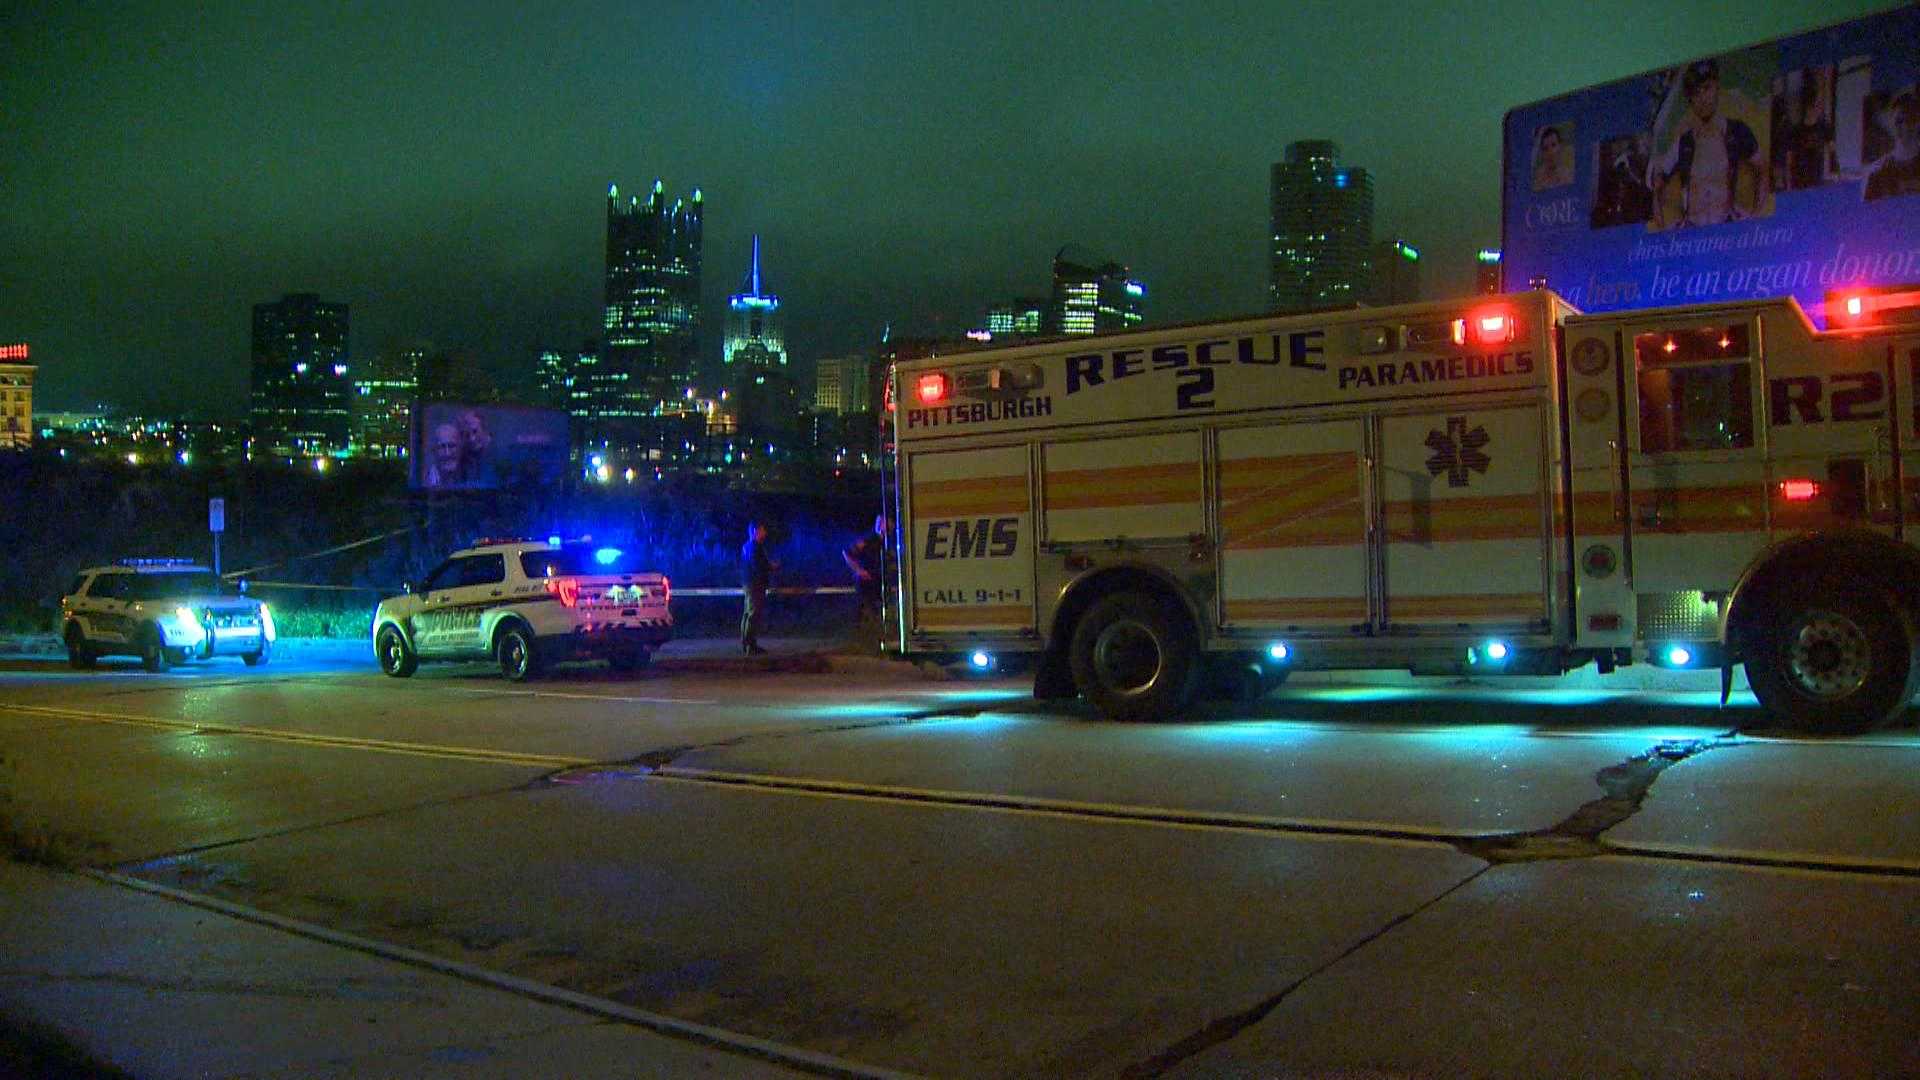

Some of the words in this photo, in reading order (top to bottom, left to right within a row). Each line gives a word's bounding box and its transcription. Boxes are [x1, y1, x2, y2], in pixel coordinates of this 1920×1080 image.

[1736, 232, 1749, 249] a
[1650, 265, 1682, 299] be
[1685, 267, 1722, 297] an
[1726, 256, 1813, 298] organ
[1065, 331, 1326, 395] RESCUE
[1338, 350, 1535, 390] PARAMEDICS
[1175, 366, 1215, 410] 2
[1769, 371, 1886, 426] R2
[908, 397, 1053, 429] PITTSBURGH
[925, 517, 1019, 560] EMS
[924, 588, 967, 604] CALL
[975, 588, 1020, 602] 9-1-1
